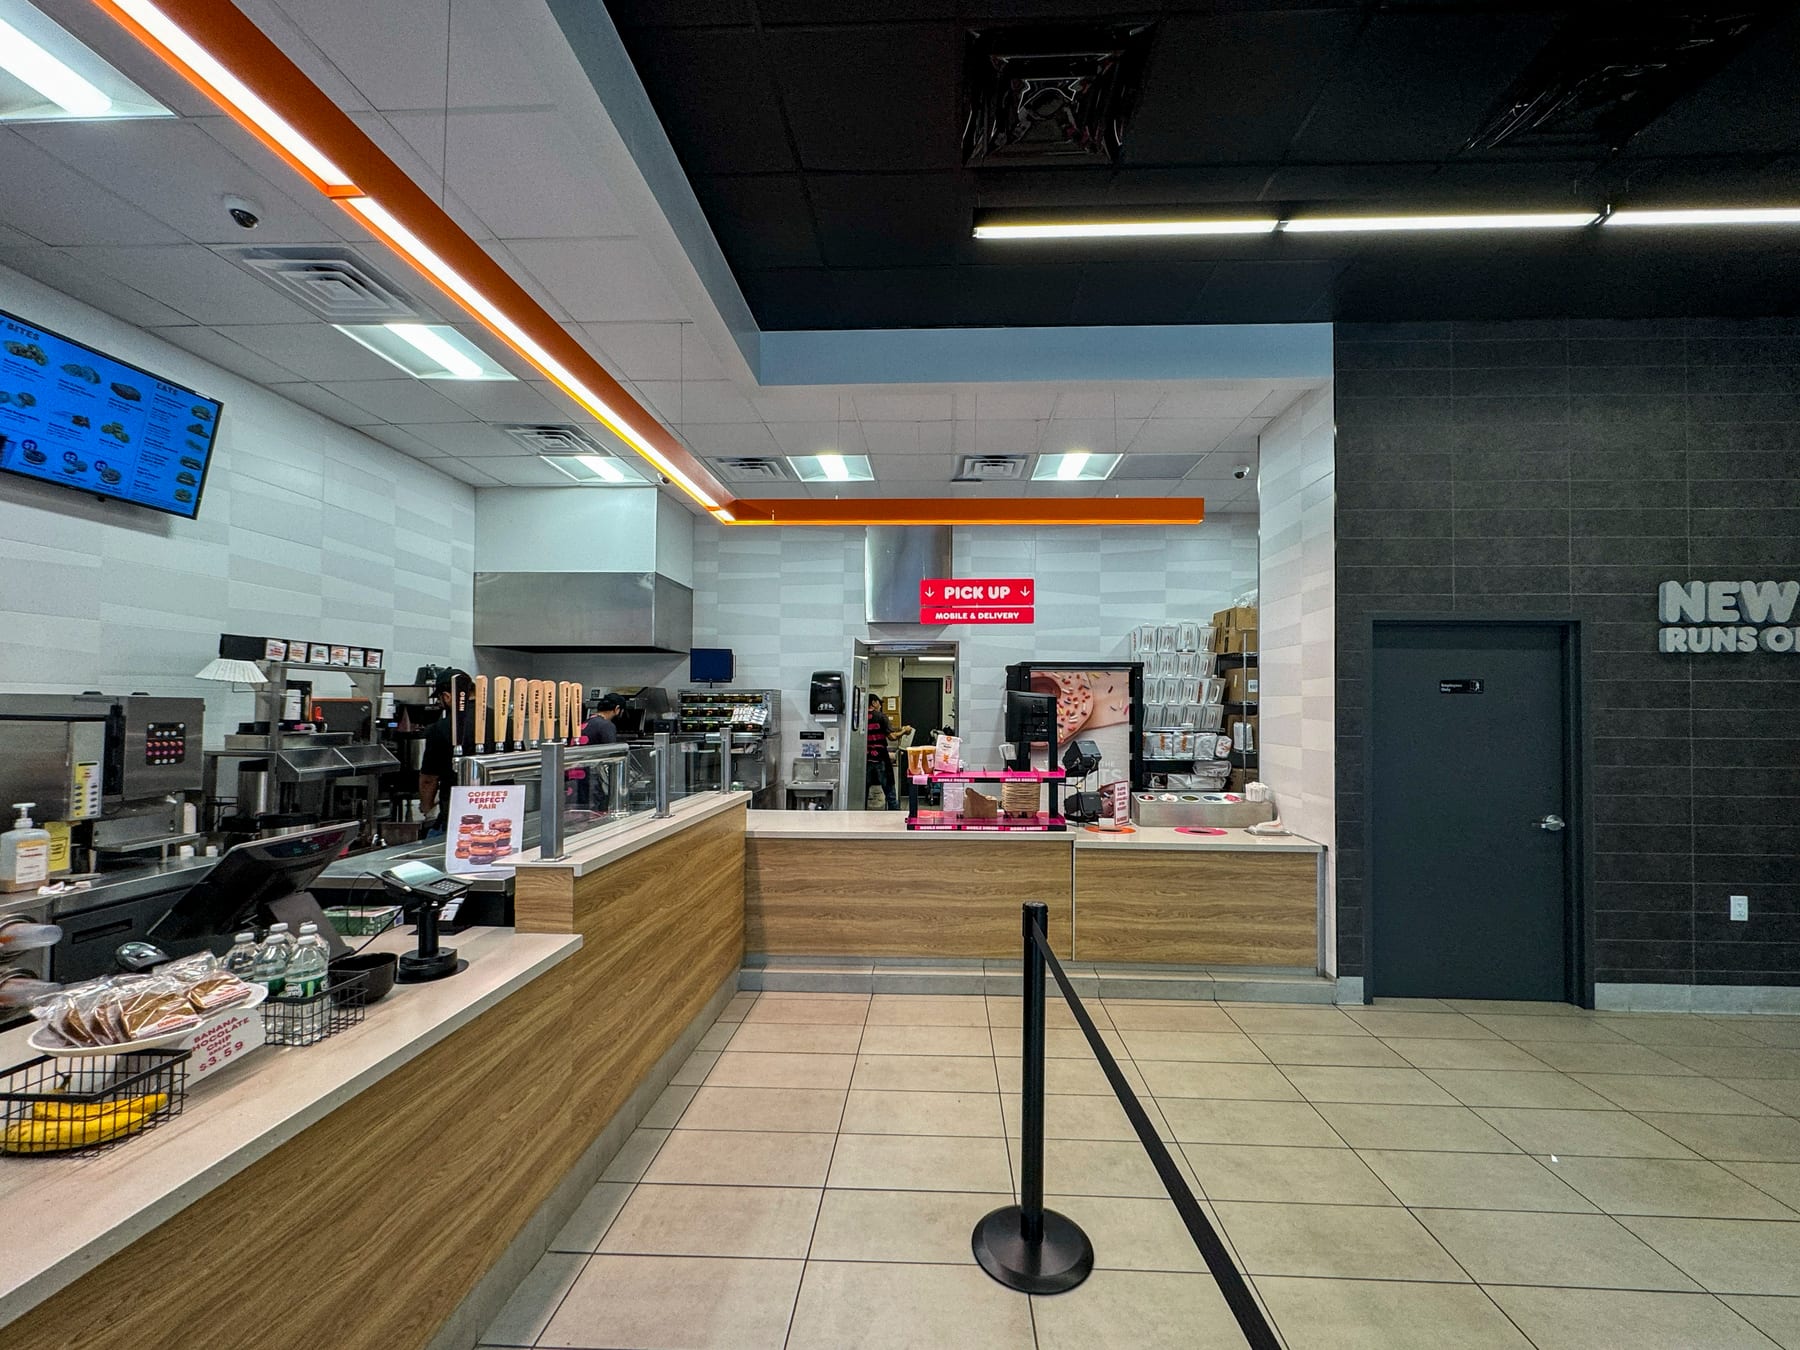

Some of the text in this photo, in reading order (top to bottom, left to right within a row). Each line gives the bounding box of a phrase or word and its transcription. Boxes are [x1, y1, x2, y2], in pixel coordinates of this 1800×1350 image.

[6, 322, 40, 341] BITES
[944, 585, 1011, 600] PICK UP
[1659, 580, 1800, 623] NEW
[935, 612, 968, 620] MOBILE
[978, 612, 1020, 620] DELIVERY
[1659, 626, 1759, 653] RUNS
[192, 1017, 250, 1052] HOCOLATE
[193, 1016, 239, 1044] BANANA
[206, 1034, 232, 1051] CHIP
